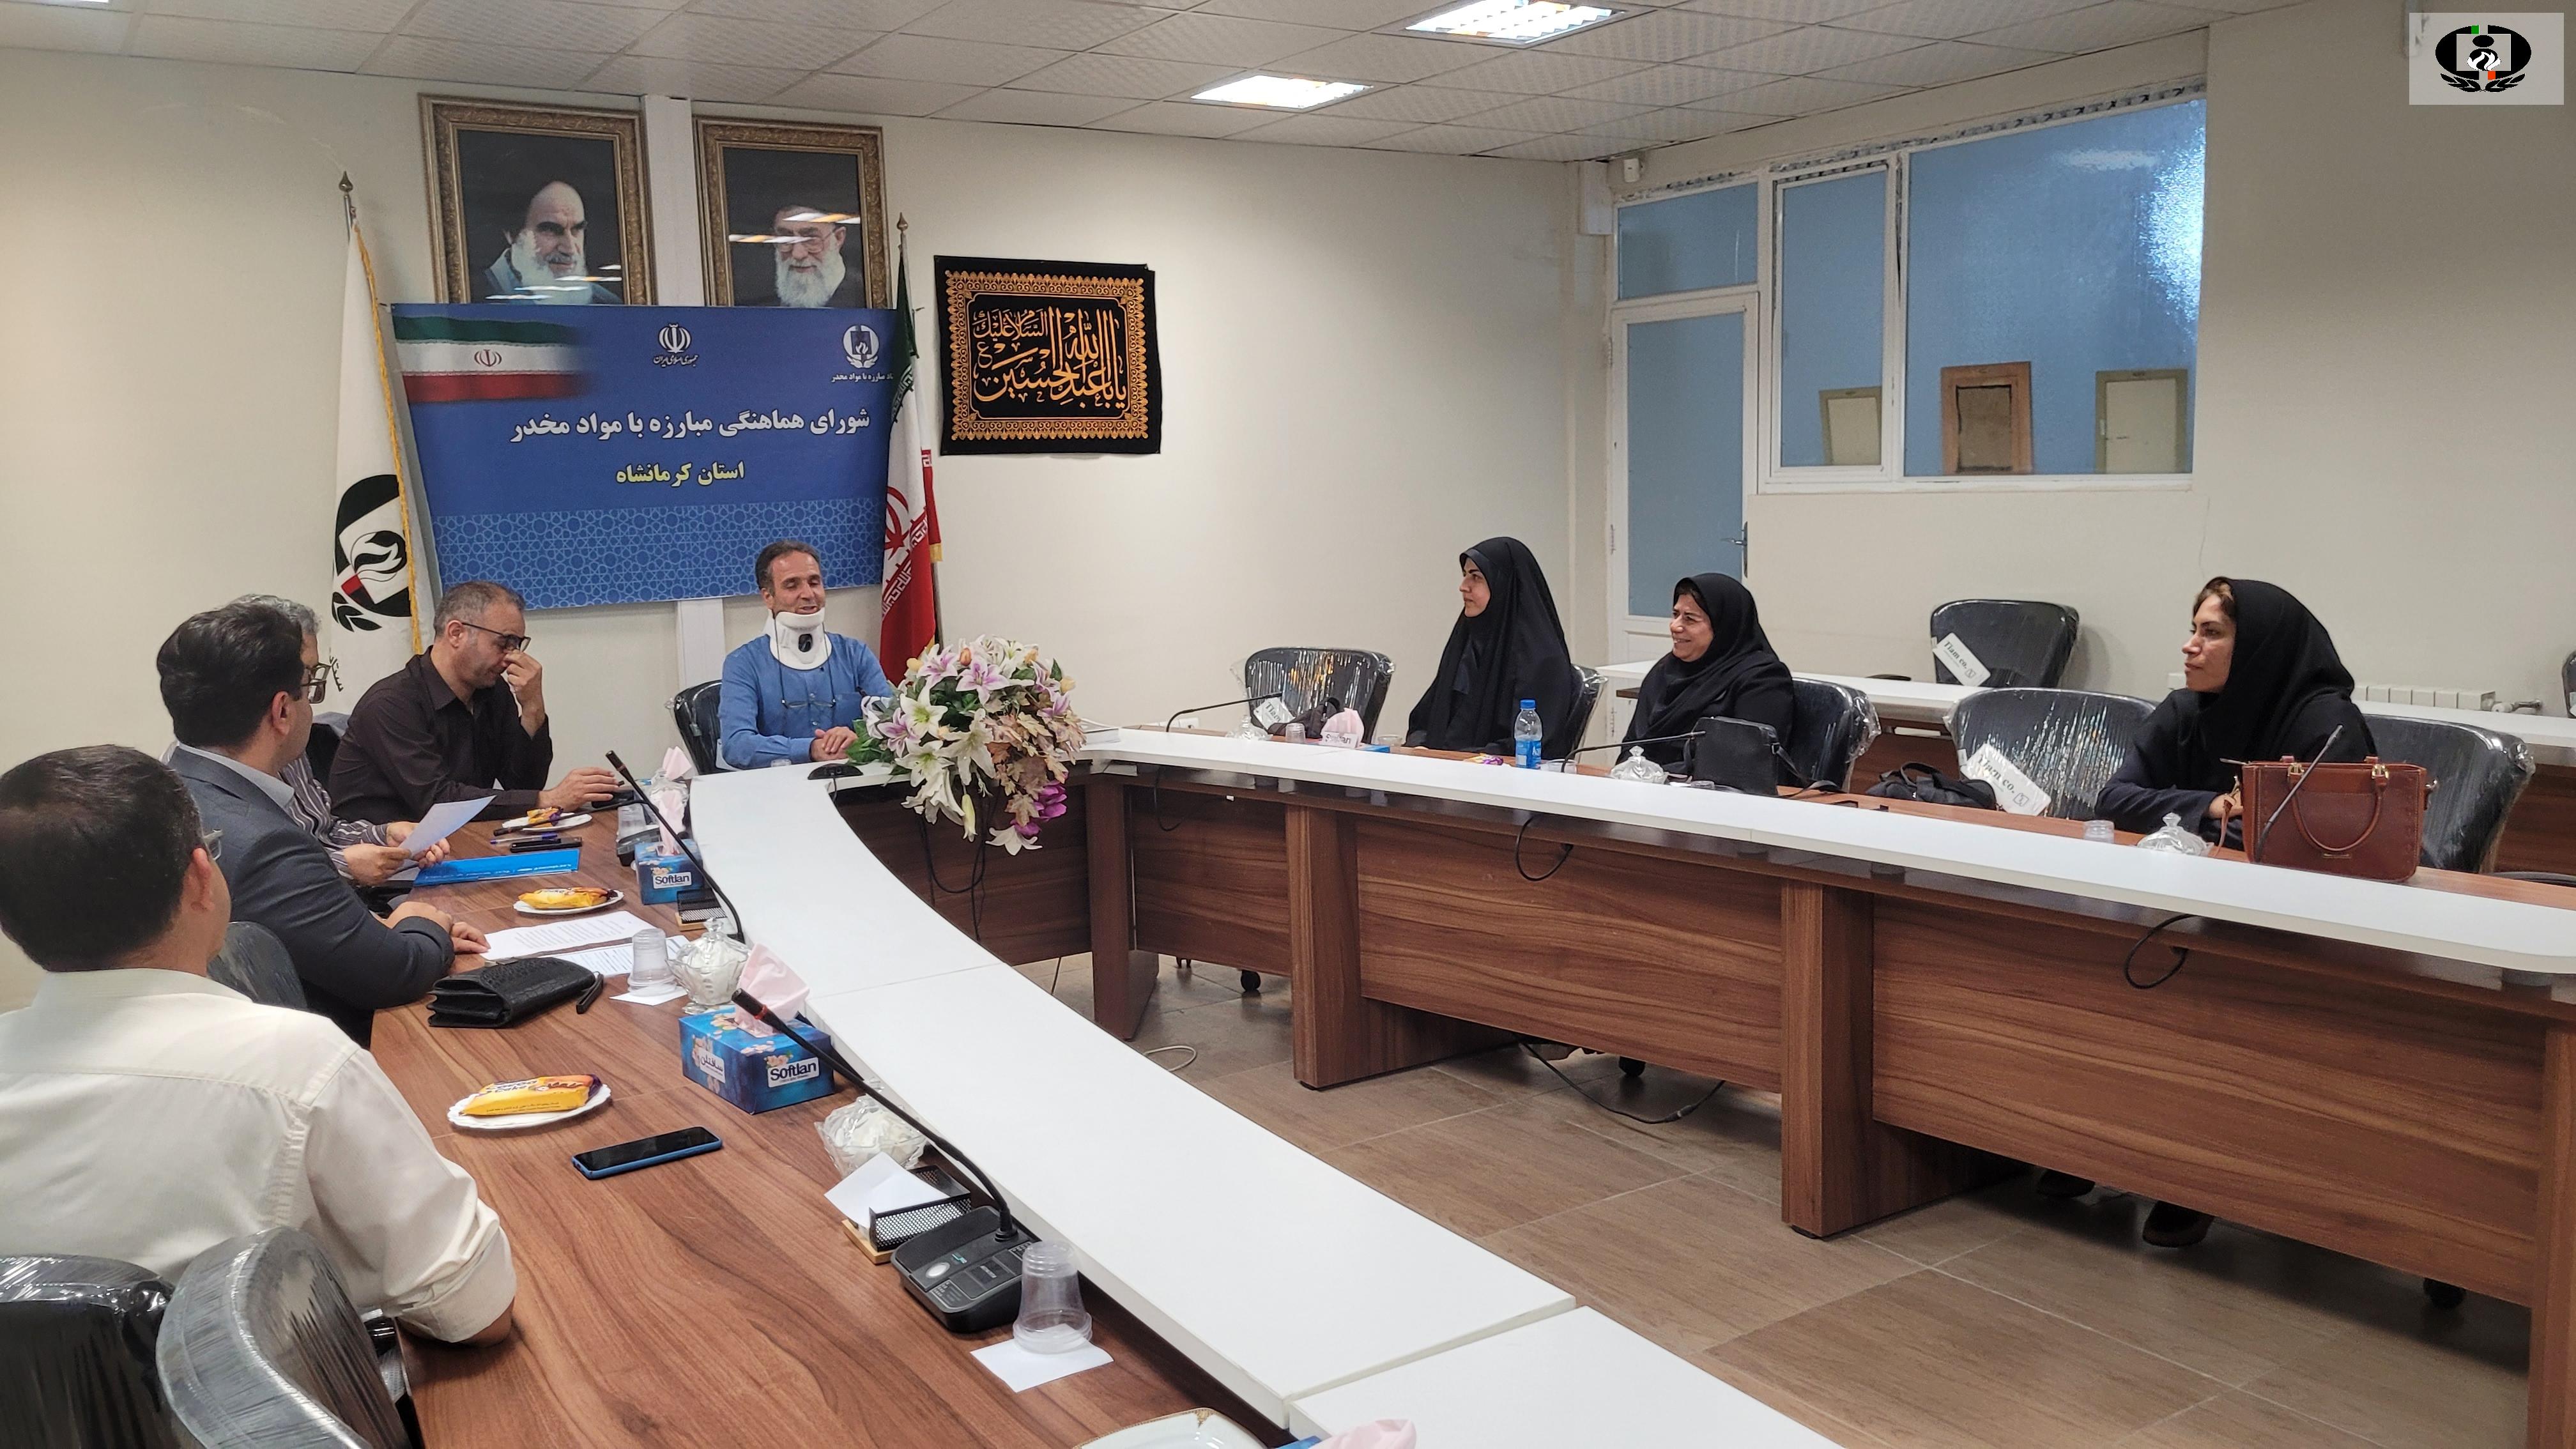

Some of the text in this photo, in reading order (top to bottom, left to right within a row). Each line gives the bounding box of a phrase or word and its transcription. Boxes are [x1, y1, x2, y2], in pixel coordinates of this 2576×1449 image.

[510, 408, 870, 442] شورای هماهنگی مبارزه با مواد مخدر
[615, 460, 745, 487] استان کرمانشاه
[655, 874, 690, 885] Softlan
[770, 1062, 817, 1081] Softlan
